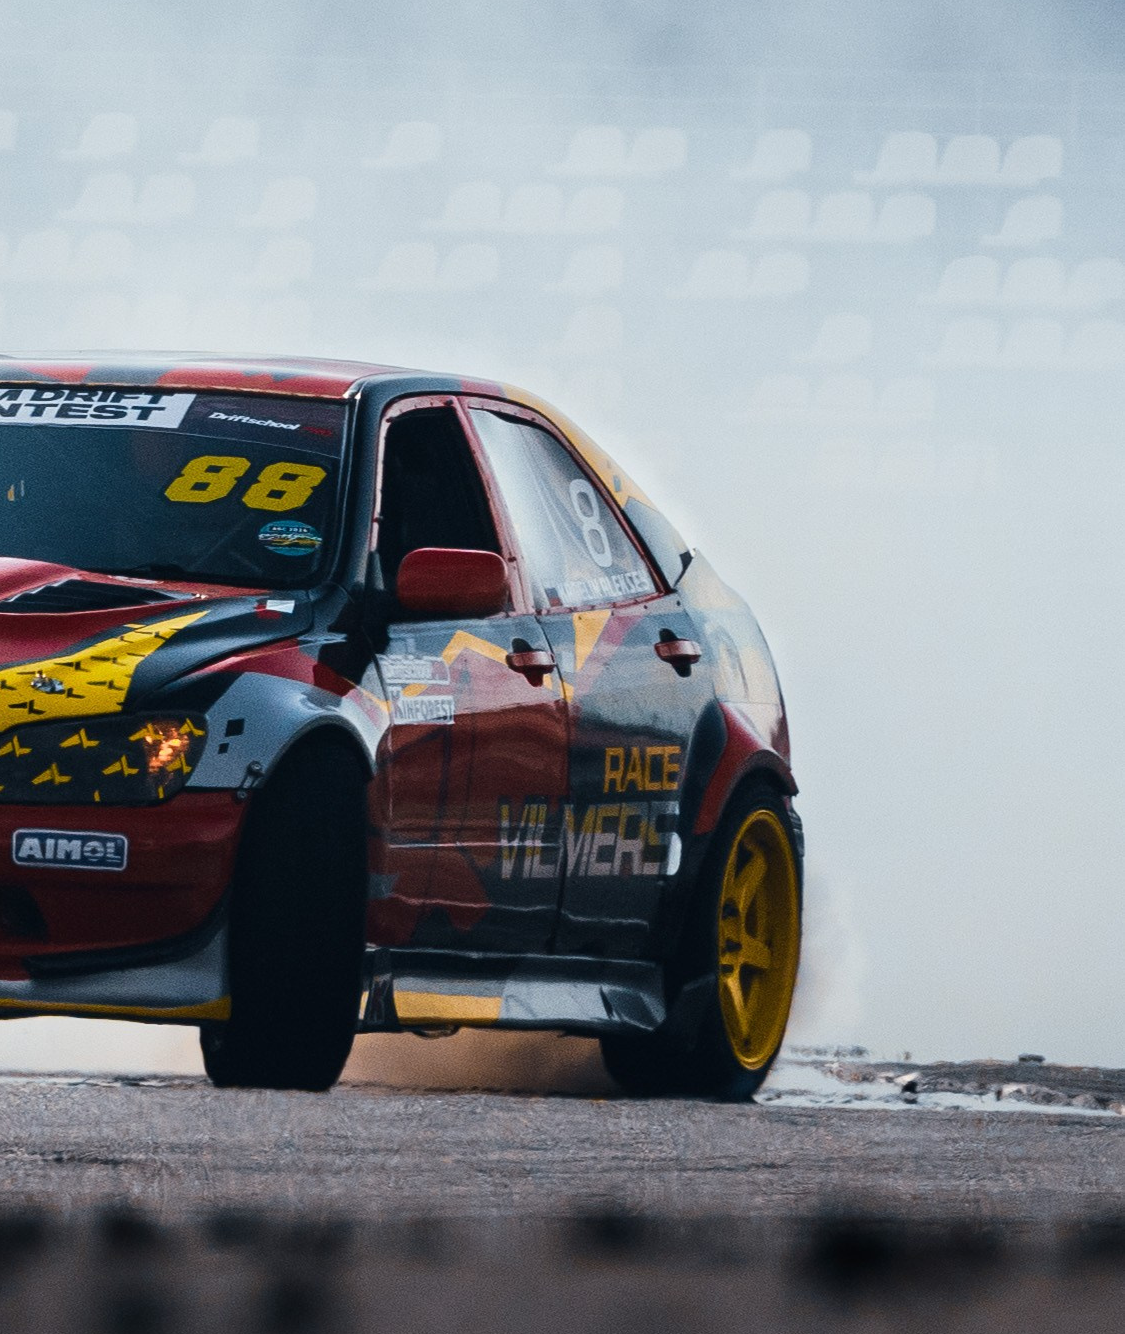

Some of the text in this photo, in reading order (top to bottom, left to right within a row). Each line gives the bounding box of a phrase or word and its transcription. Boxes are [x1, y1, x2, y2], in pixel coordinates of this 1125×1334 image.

[29, 389, 173, 405] DRIFT
[208, 412, 301, 430] Driftschool
[164, 455, 327, 511] 88
[569, 479, 612, 567] 8
[603, 745, 681, 793] RACE
[18, 838, 121, 863] AIMOL
[500, 801, 682, 879] VILMERS
